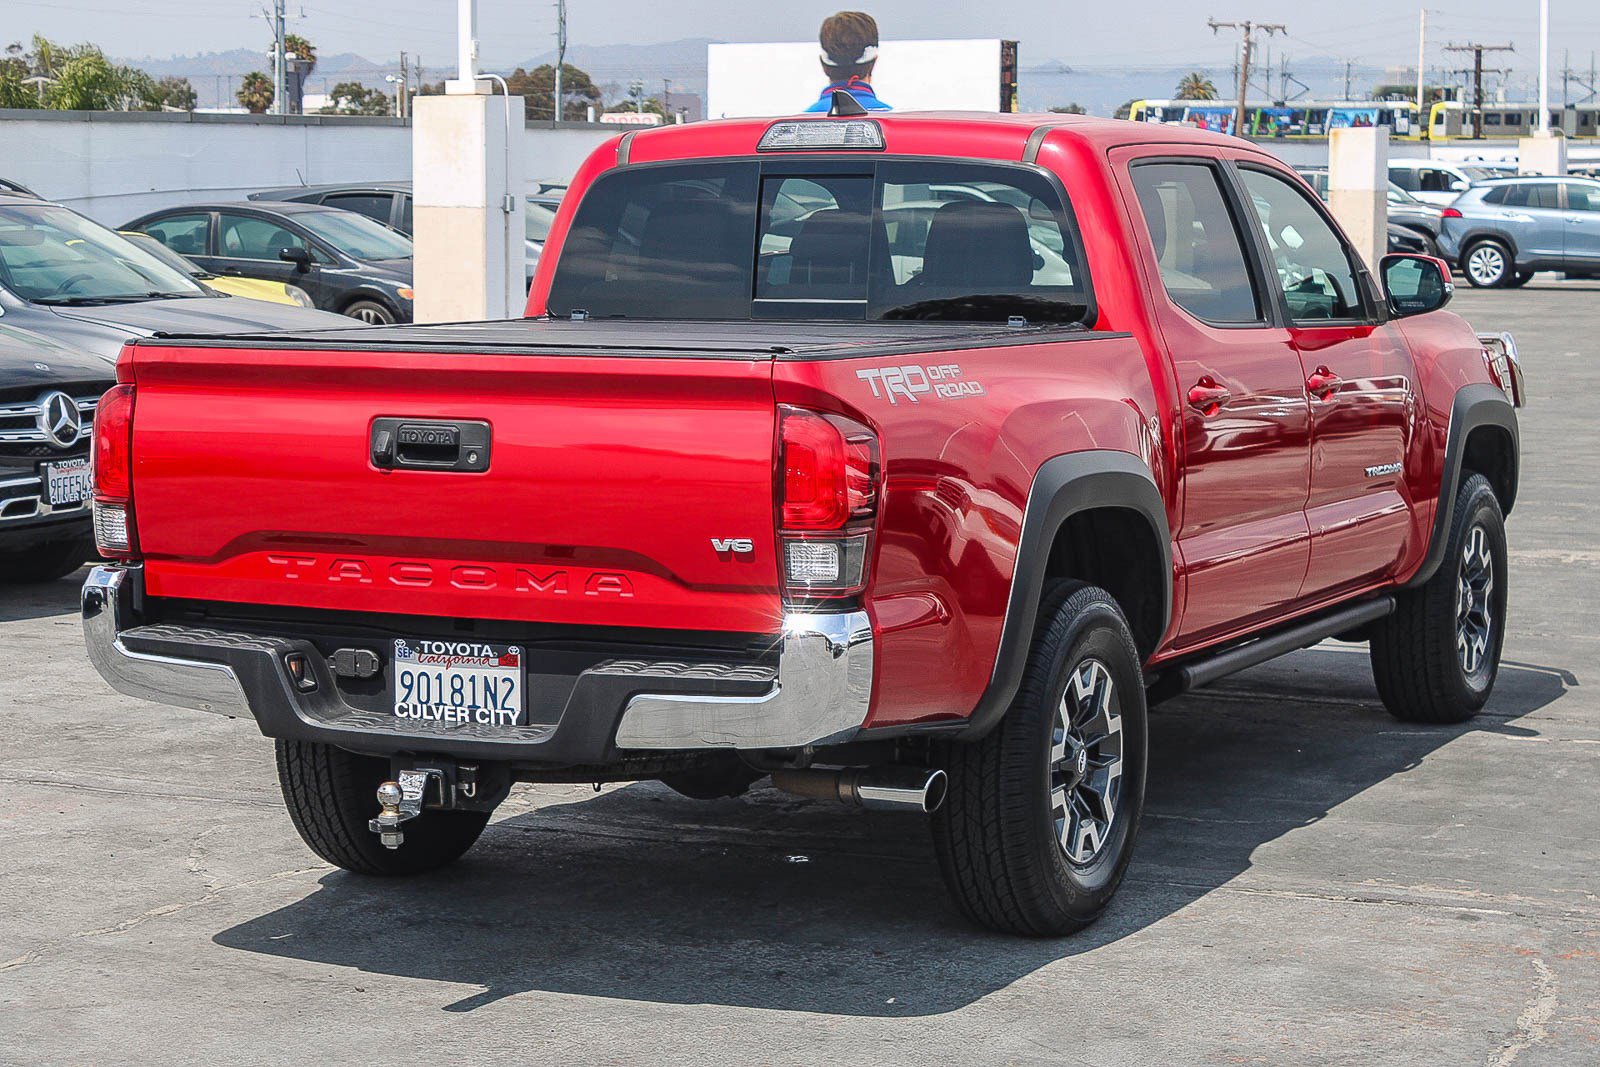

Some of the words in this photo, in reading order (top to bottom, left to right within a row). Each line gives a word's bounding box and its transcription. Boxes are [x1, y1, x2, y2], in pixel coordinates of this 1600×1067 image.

[855, 365, 931, 404] TRD
[926, 364, 961, 380] OFF
[933, 381, 985, 399] ROAD
[401, 430, 455, 444] TOYOTA
[58, 459, 86, 468] TOYOTA
[50, 491, 80, 505] CULVER
[710, 538, 753, 553] V6
[267, 555, 634, 597] TACOMA
[420, 640, 494, 657] TOYOTA
[417, 653, 499, 670] California
[400, 670, 517, 711] 90181N2
[394, 702, 470, 722] CULVER
[475, 707, 520, 726] CITY
